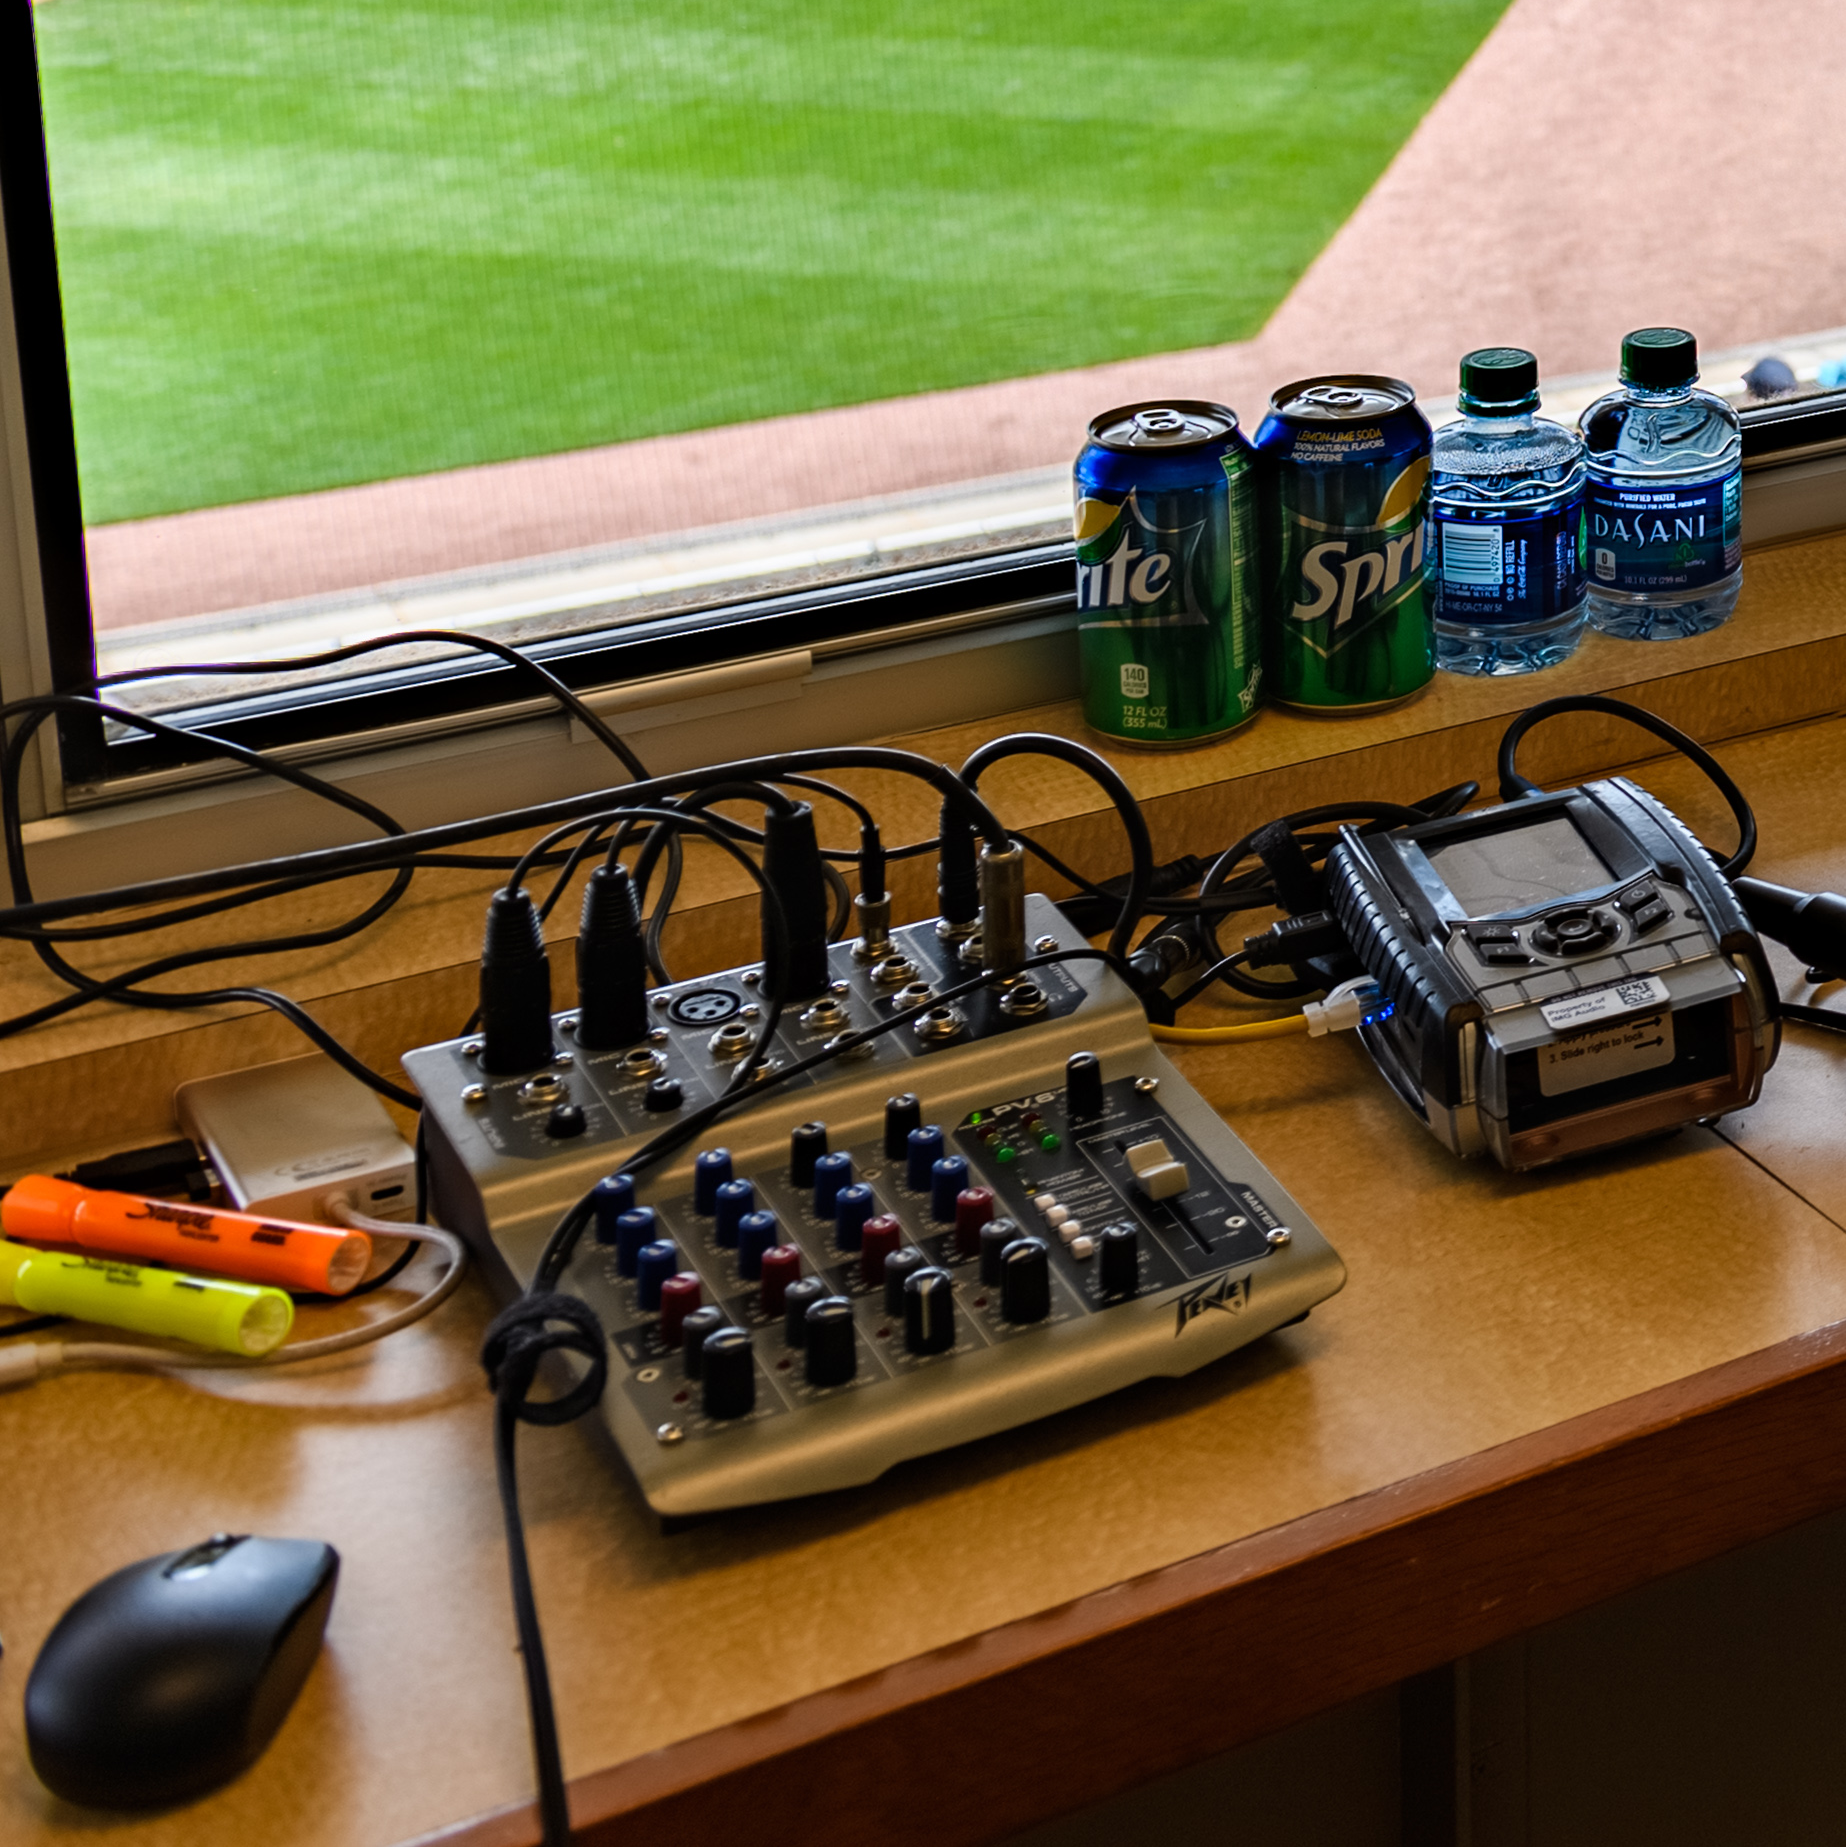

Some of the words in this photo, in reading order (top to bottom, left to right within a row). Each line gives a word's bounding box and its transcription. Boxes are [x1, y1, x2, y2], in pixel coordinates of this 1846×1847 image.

[1297, 429, 1355, 443] LEMON-LIME
[1356, 427, 1383, 442] SODA
[1313, 441, 1351, 453] NATURAL
[1351, 438, 1385, 452] FLAVORS
[1303, 451, 1344, 463] CAFFEINE
[1619, 492, 1652, 502] PURIFIED
[1652, 492, 1676, 502] WATER
[1594, 512, 1706, 551] DASANI
[1648, 576, 1658, 585] OZ
[1123, 666, 1146, 683] 140
[1122, 705, 1134, 716] 12
[1135, 705, 1148, 717] FL
[1149, 705, 1168, 717] OZ
[1122, 716, 1147, 729] (355
[1547, 1000, 1594, 1018] Property
[1595, 995, 1607, 1006] of
[1550, 1011, 1574, 1024] IMG
[1574, 1003, 1607, 1019] Audio
[1548, 1053, 1559, 1065] 3.
[1560, 1047, 1586, 1062] Slide
[1586, 1039, 1611, 1056] right
[1611, 1036, 1624, 1047] to
[1623, 1030, 1646, 1045] lock
[1240, 1190, 1280, 1229] MASTER
